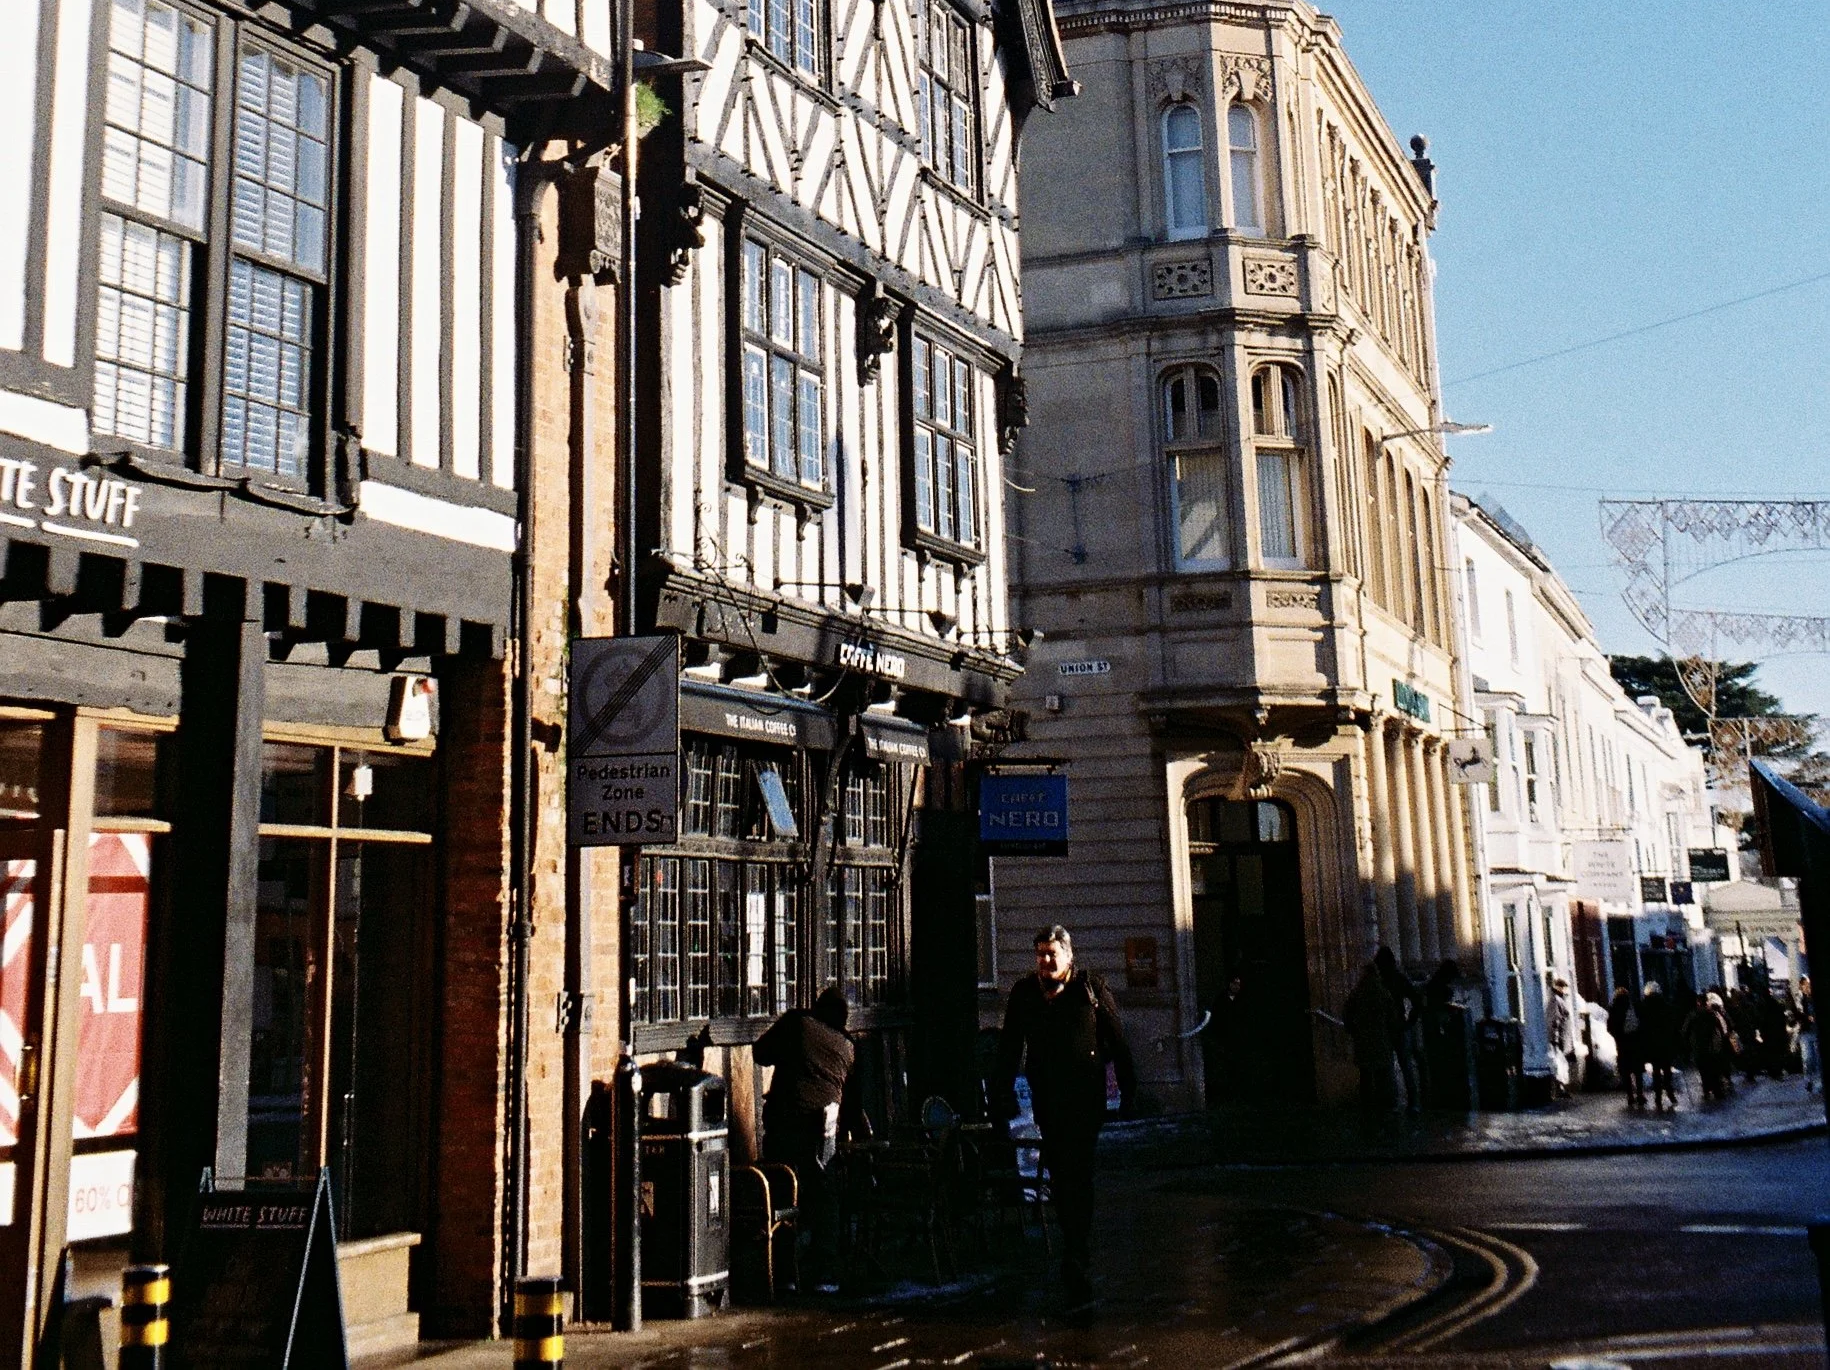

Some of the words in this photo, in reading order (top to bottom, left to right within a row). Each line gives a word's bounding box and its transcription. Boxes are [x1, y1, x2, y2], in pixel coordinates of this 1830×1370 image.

[44, 467, 141, 528] STUFF
[876, 652, 905, 679] NERO
[1060, 663, 1093, 674] UNION
[1097, 662, 1108, 671] ST
[725, 713, 739, 728] THE
[739, 715, 764, 732] ITALIAN
[765, 719, 789, 736] COFFEE
[899, 743, 919, 758] COFFEE
[577, 763, 671, 781] Pedestrian
[602, 784, 645, 800] Zone
[583, 809, 661, 835] ENDS
[989, 810, 1059, 827] NERO
[75, 1186, 112, 1214] 60%
[202, 1206, 252, 1223] WHITE
[256, 1205, 308, 1223] STUFF
